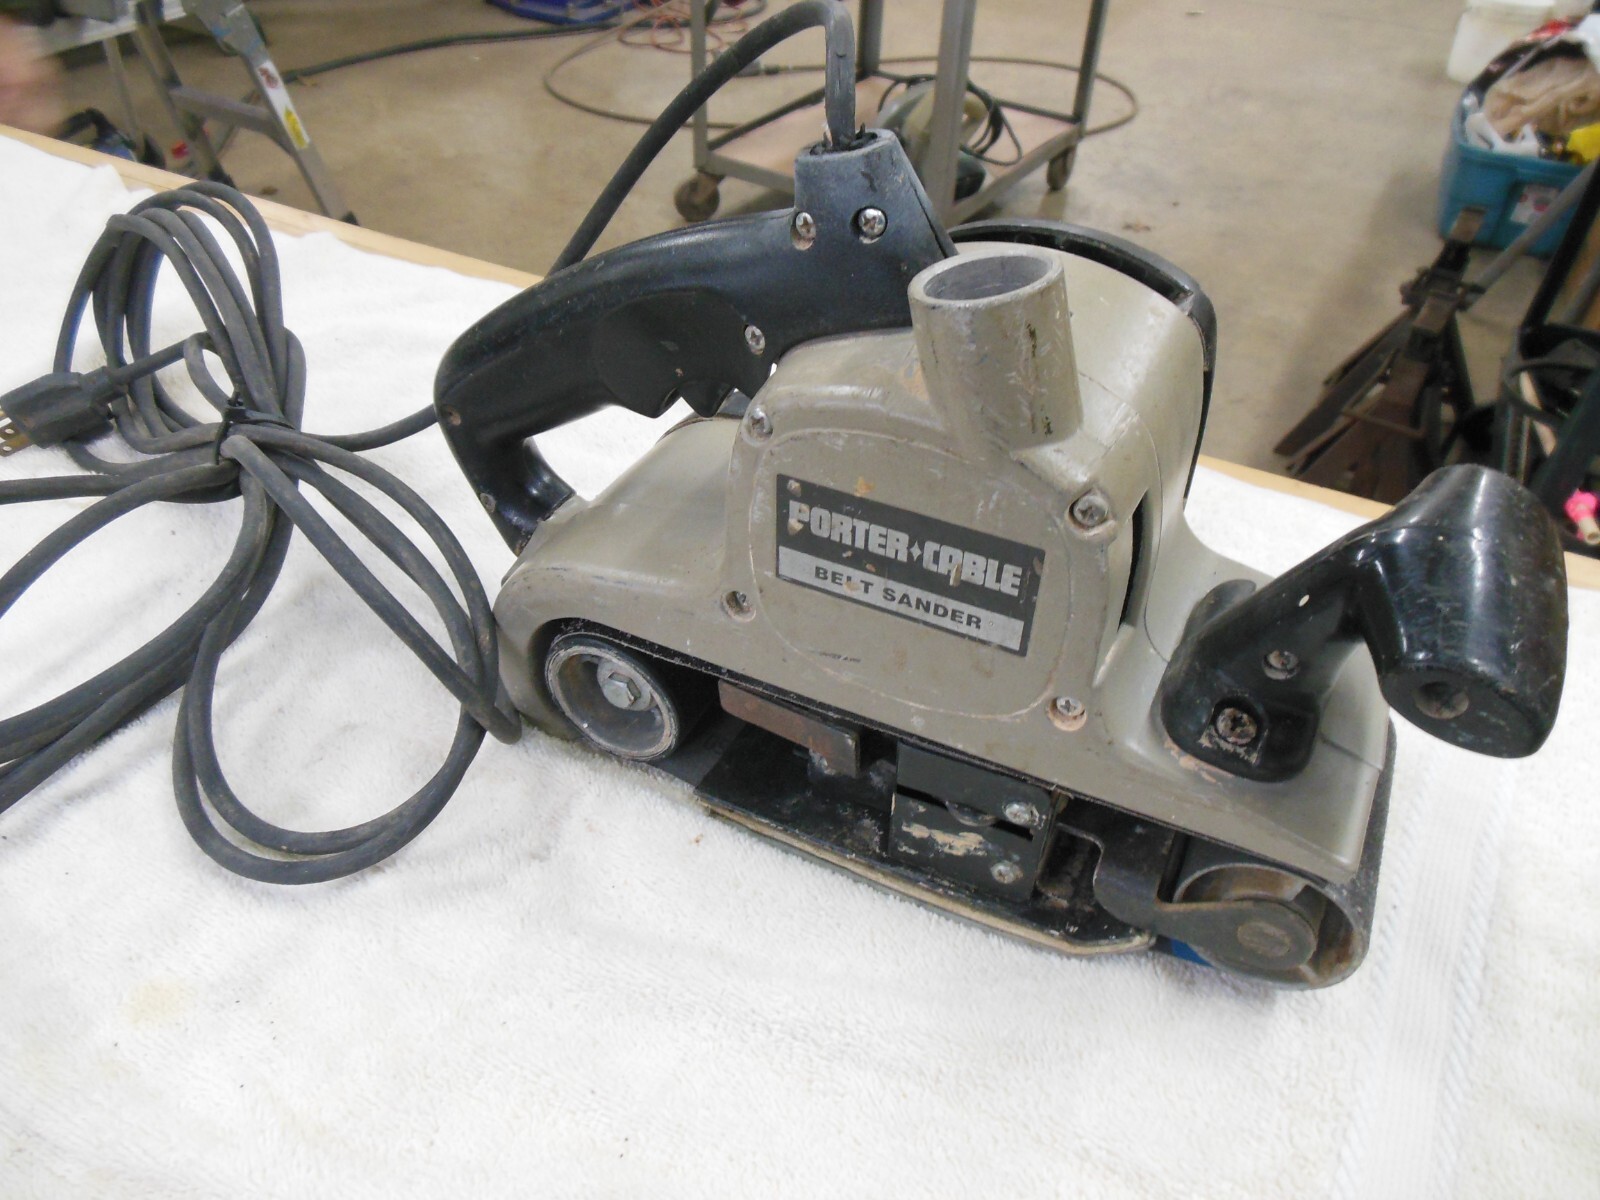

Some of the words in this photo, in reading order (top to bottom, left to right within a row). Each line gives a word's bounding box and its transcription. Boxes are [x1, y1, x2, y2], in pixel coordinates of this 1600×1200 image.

[788, 500, 909, 562] PORTER
[922, 540, 1022, 597] CABLE
[882, 588, 982, 629] SANDER
